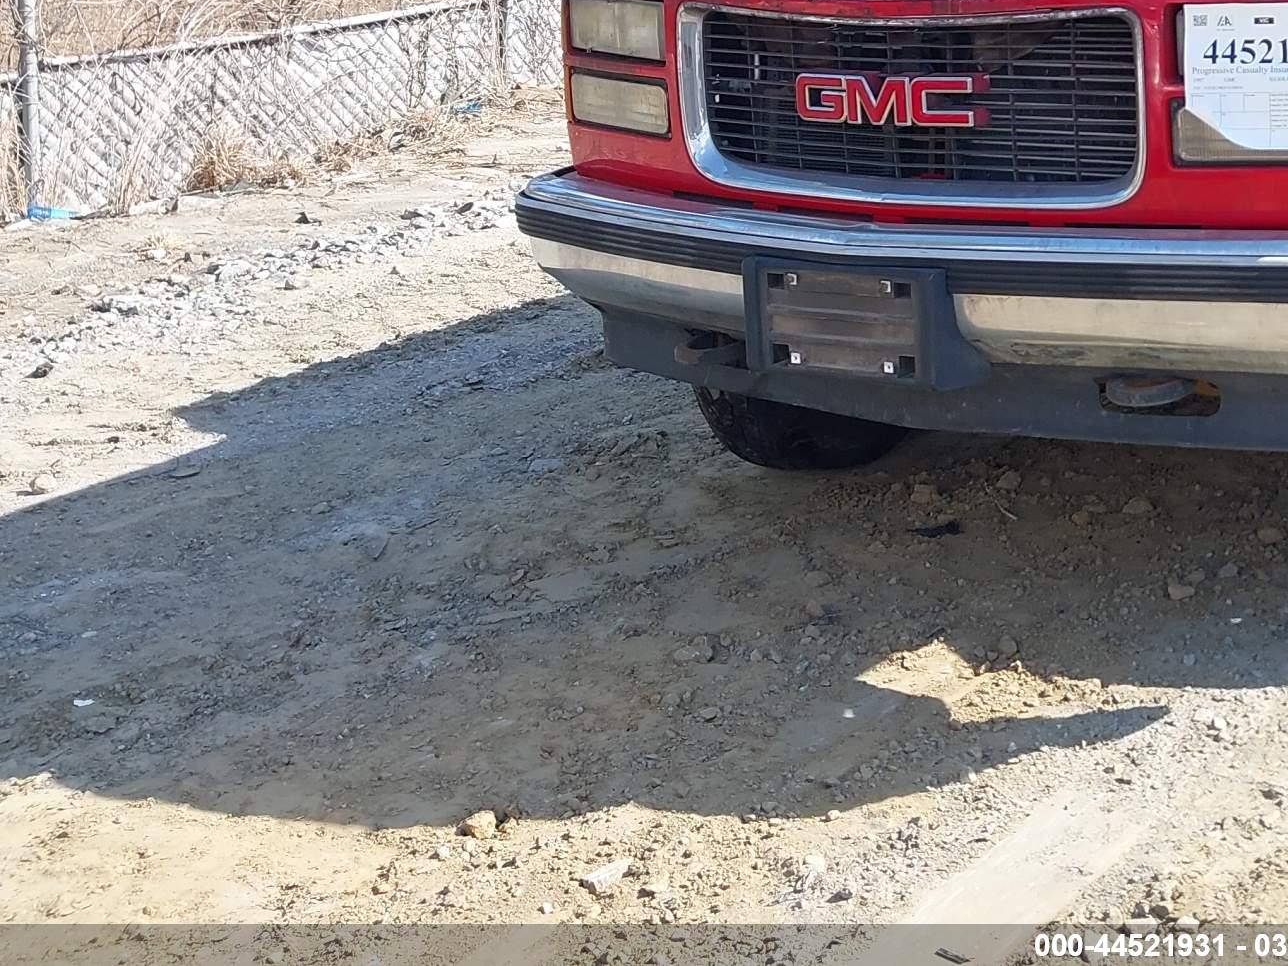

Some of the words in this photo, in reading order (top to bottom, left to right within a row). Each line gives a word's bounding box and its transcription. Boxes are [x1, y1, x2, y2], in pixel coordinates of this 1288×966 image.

[1192, 66, 1234, 76] Progressive
[1236, 65, 1269, 75] Casualty
[796, 73, 974, 127] GMC
